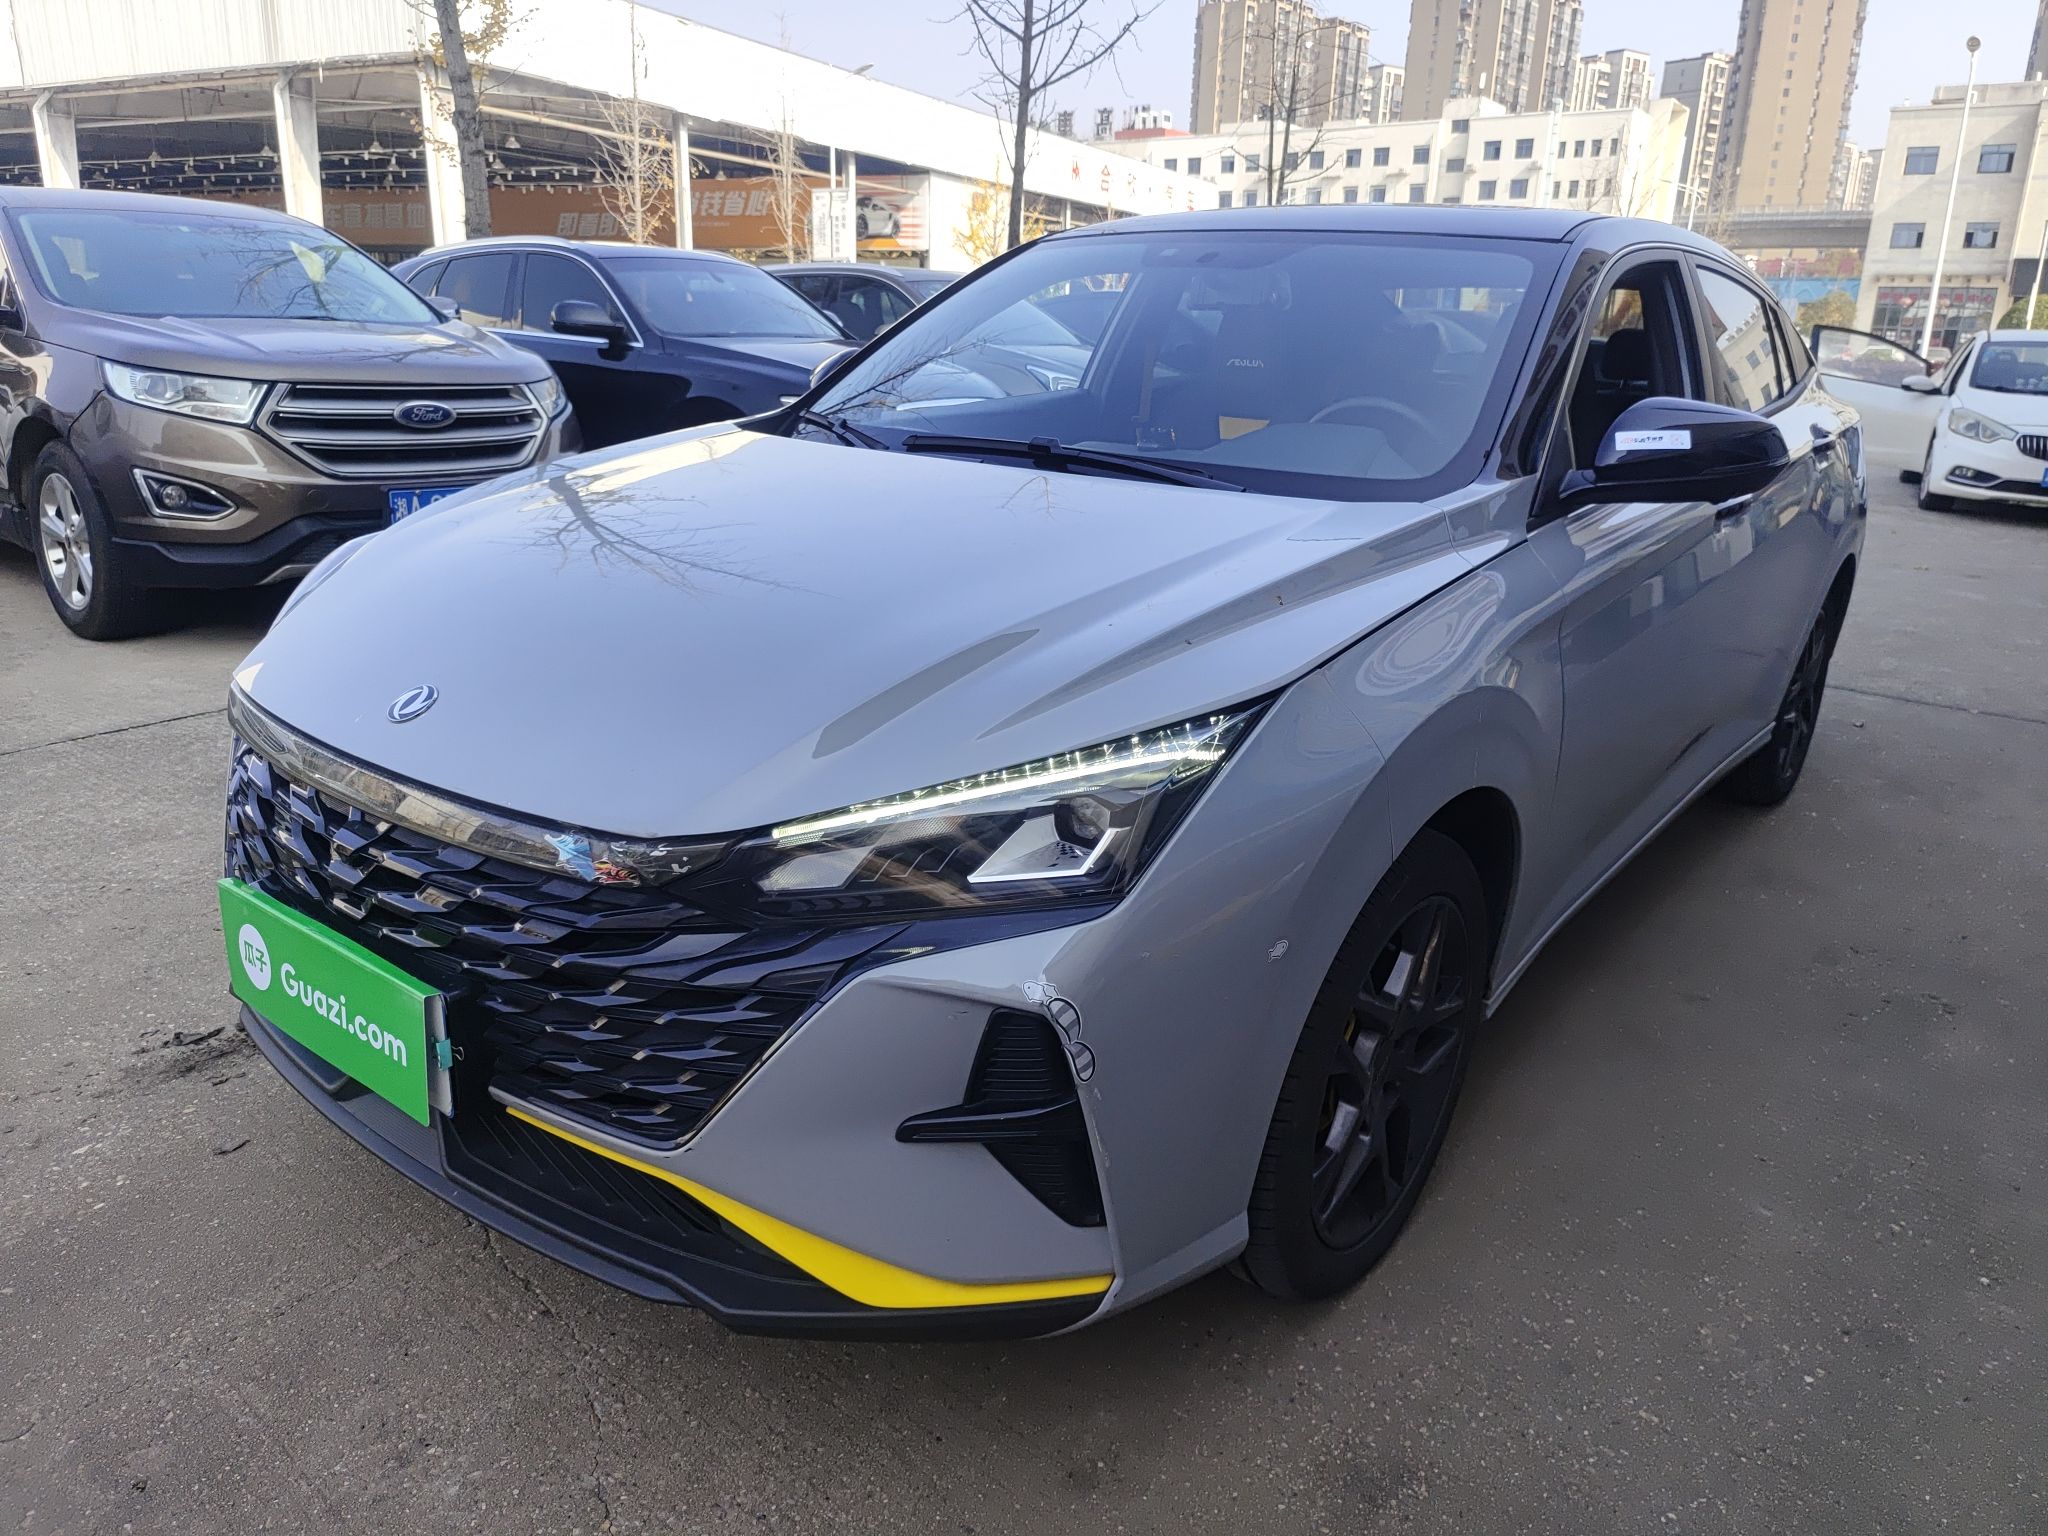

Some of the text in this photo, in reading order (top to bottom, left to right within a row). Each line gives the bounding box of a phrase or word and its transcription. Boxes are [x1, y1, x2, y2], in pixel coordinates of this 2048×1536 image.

[411, 407, 443, 421] Ford
[391, 494, 446, 522] 湘A
[243, 940, 267, 973] 瓜子
[280, 962, 407, 1067] Guazi.com
